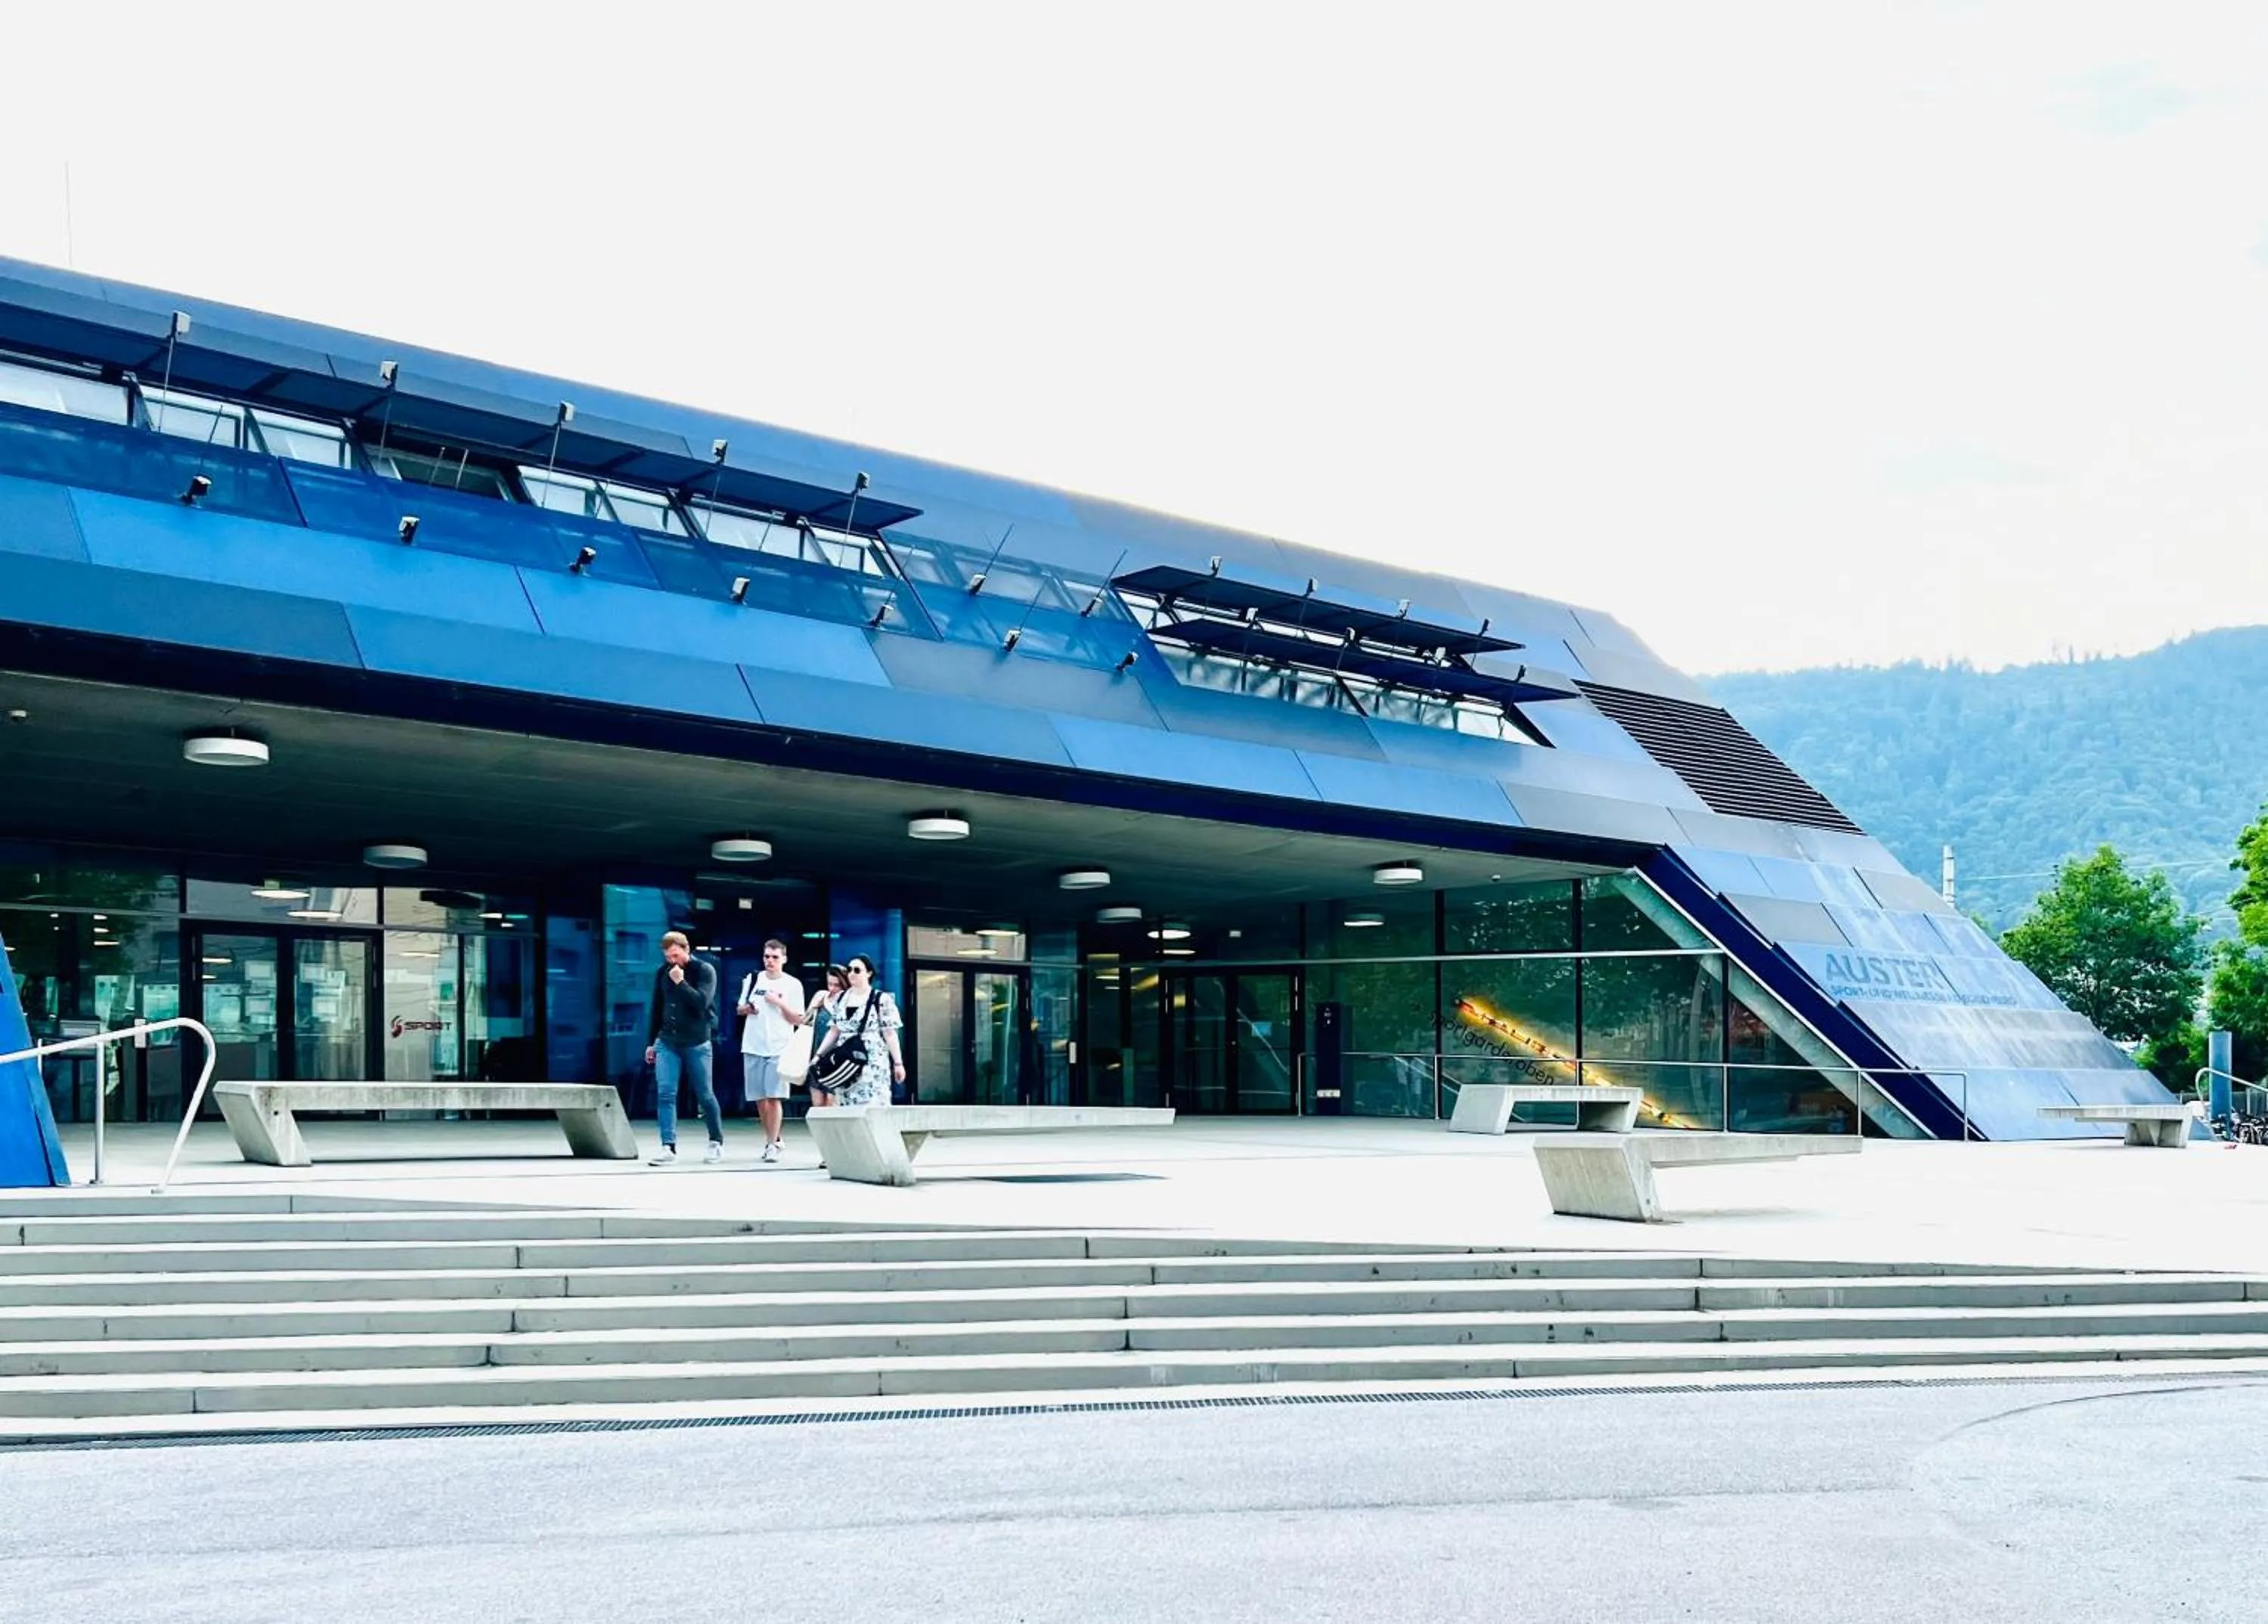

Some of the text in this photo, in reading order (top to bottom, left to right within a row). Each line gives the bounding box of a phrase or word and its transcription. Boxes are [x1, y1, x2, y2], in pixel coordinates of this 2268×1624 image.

[1825, 953, 1945, 990] AUSTER
[404, 1021, 452, 1030] SPORT
[1428, 1011, 1554, 1086] sportgardeoben
